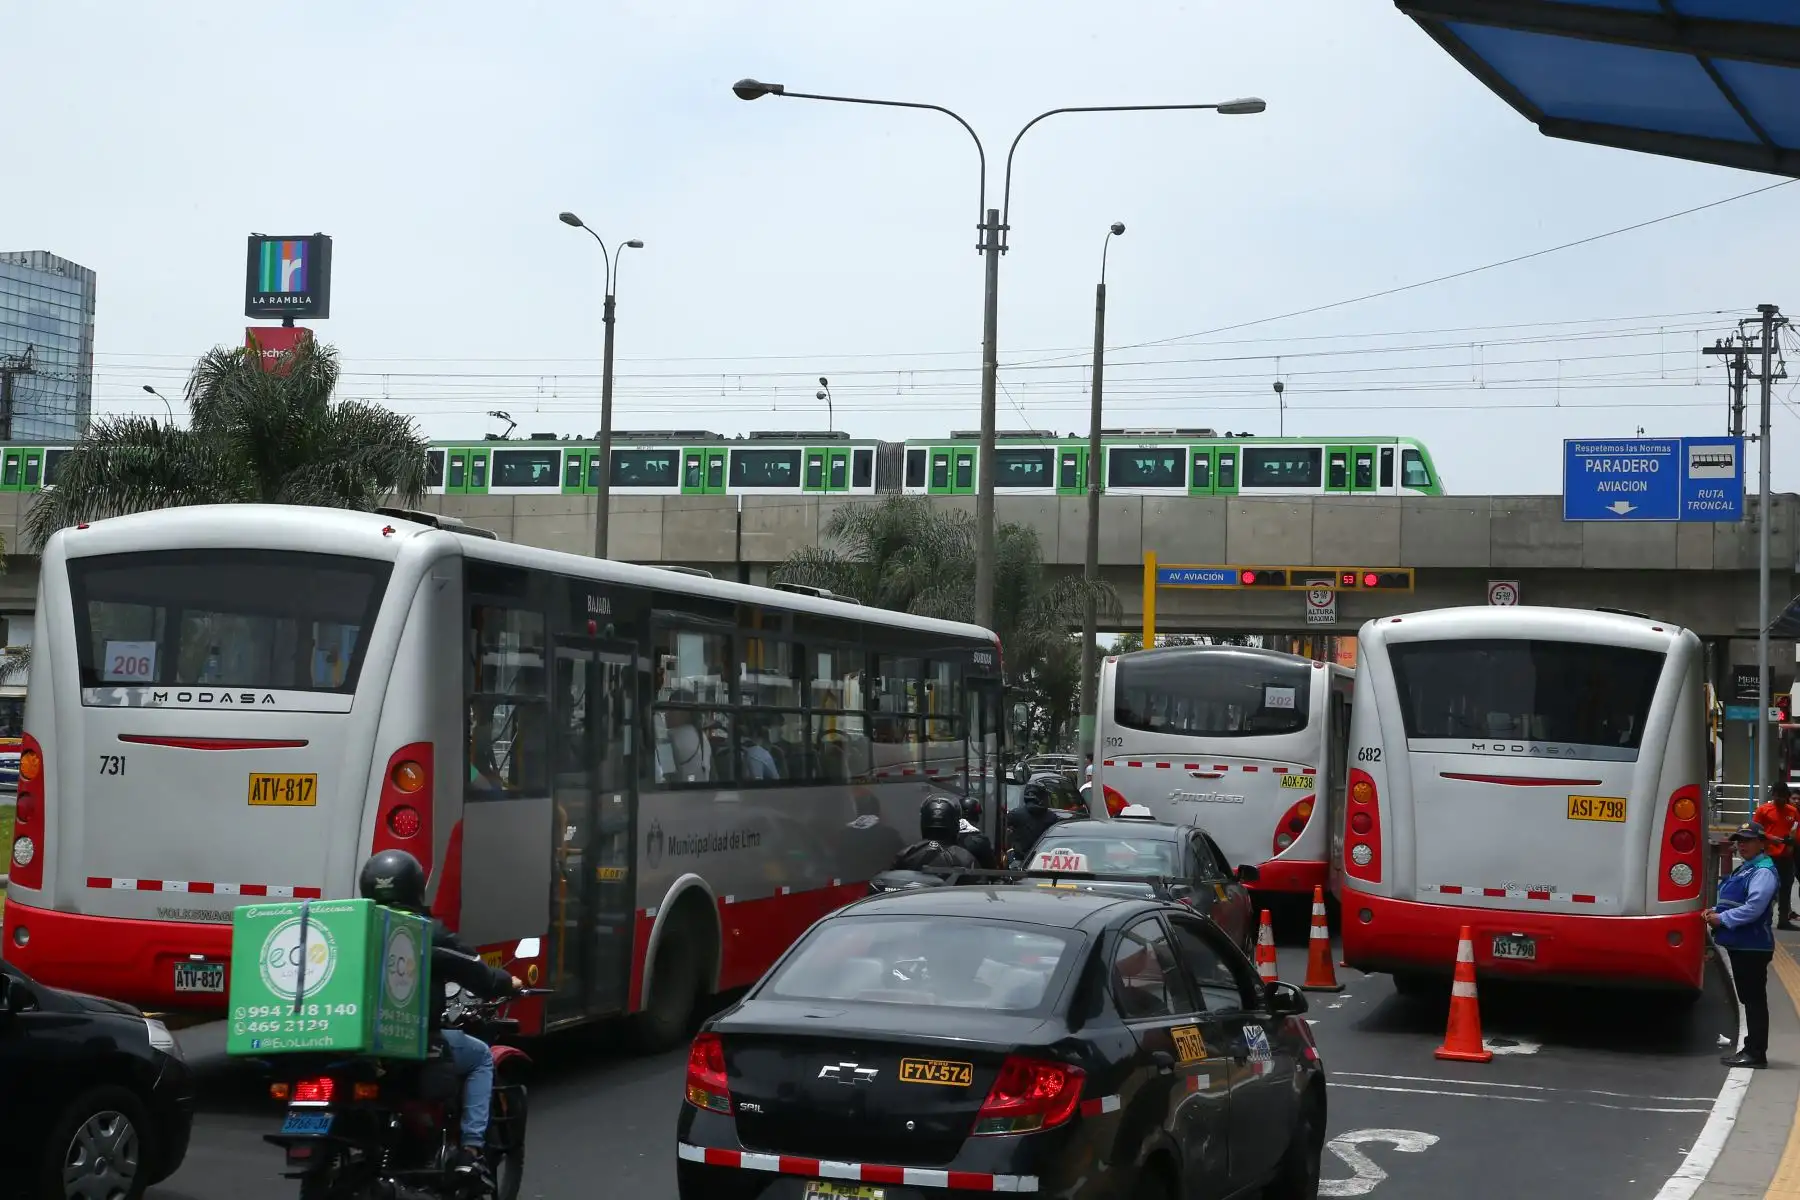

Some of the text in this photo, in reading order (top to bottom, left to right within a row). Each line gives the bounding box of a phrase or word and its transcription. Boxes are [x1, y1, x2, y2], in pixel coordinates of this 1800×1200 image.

[252, 296, 312, 304] LA RAMBLA
[1575, 444, 1671, 453] Respetemos las Normas
[1585, 459, 1659, 473] PARADERO
[1597, 481, 1647, 492] AVIACION
[1698, 490, 1724, 499] RUTA
[1688, 501, 1735, 510] TRONCAL
[1169, 572, 1224, 581] AV. AVIACIÓN
[1343, 575, 1354, 584] 53
[112, 656, 150, 675] 206
[153, 691, 275, 704] MODASA
[1269, 696, 1292, 706] 202
[1358, 747, 1382, 762] 682
[1472, 743, 1576, 755] MODASA
[99, 755, 126, 776] 731
[252, 778, 313, 801] ATV-817
[1571, 800, 1624, 818] ASI-798
[729, 829, 740, 850] de
[1041, 856, 1080, 871] TAXI
[176, 970, 223, 988] ATV-817
[248, 1005, 281, 1017] 994
[325, 1003, 357, 1016] 140
[248, 1019, 329, 1033] 469 2129
[904, 1063, 970, 1083] F7V-574
